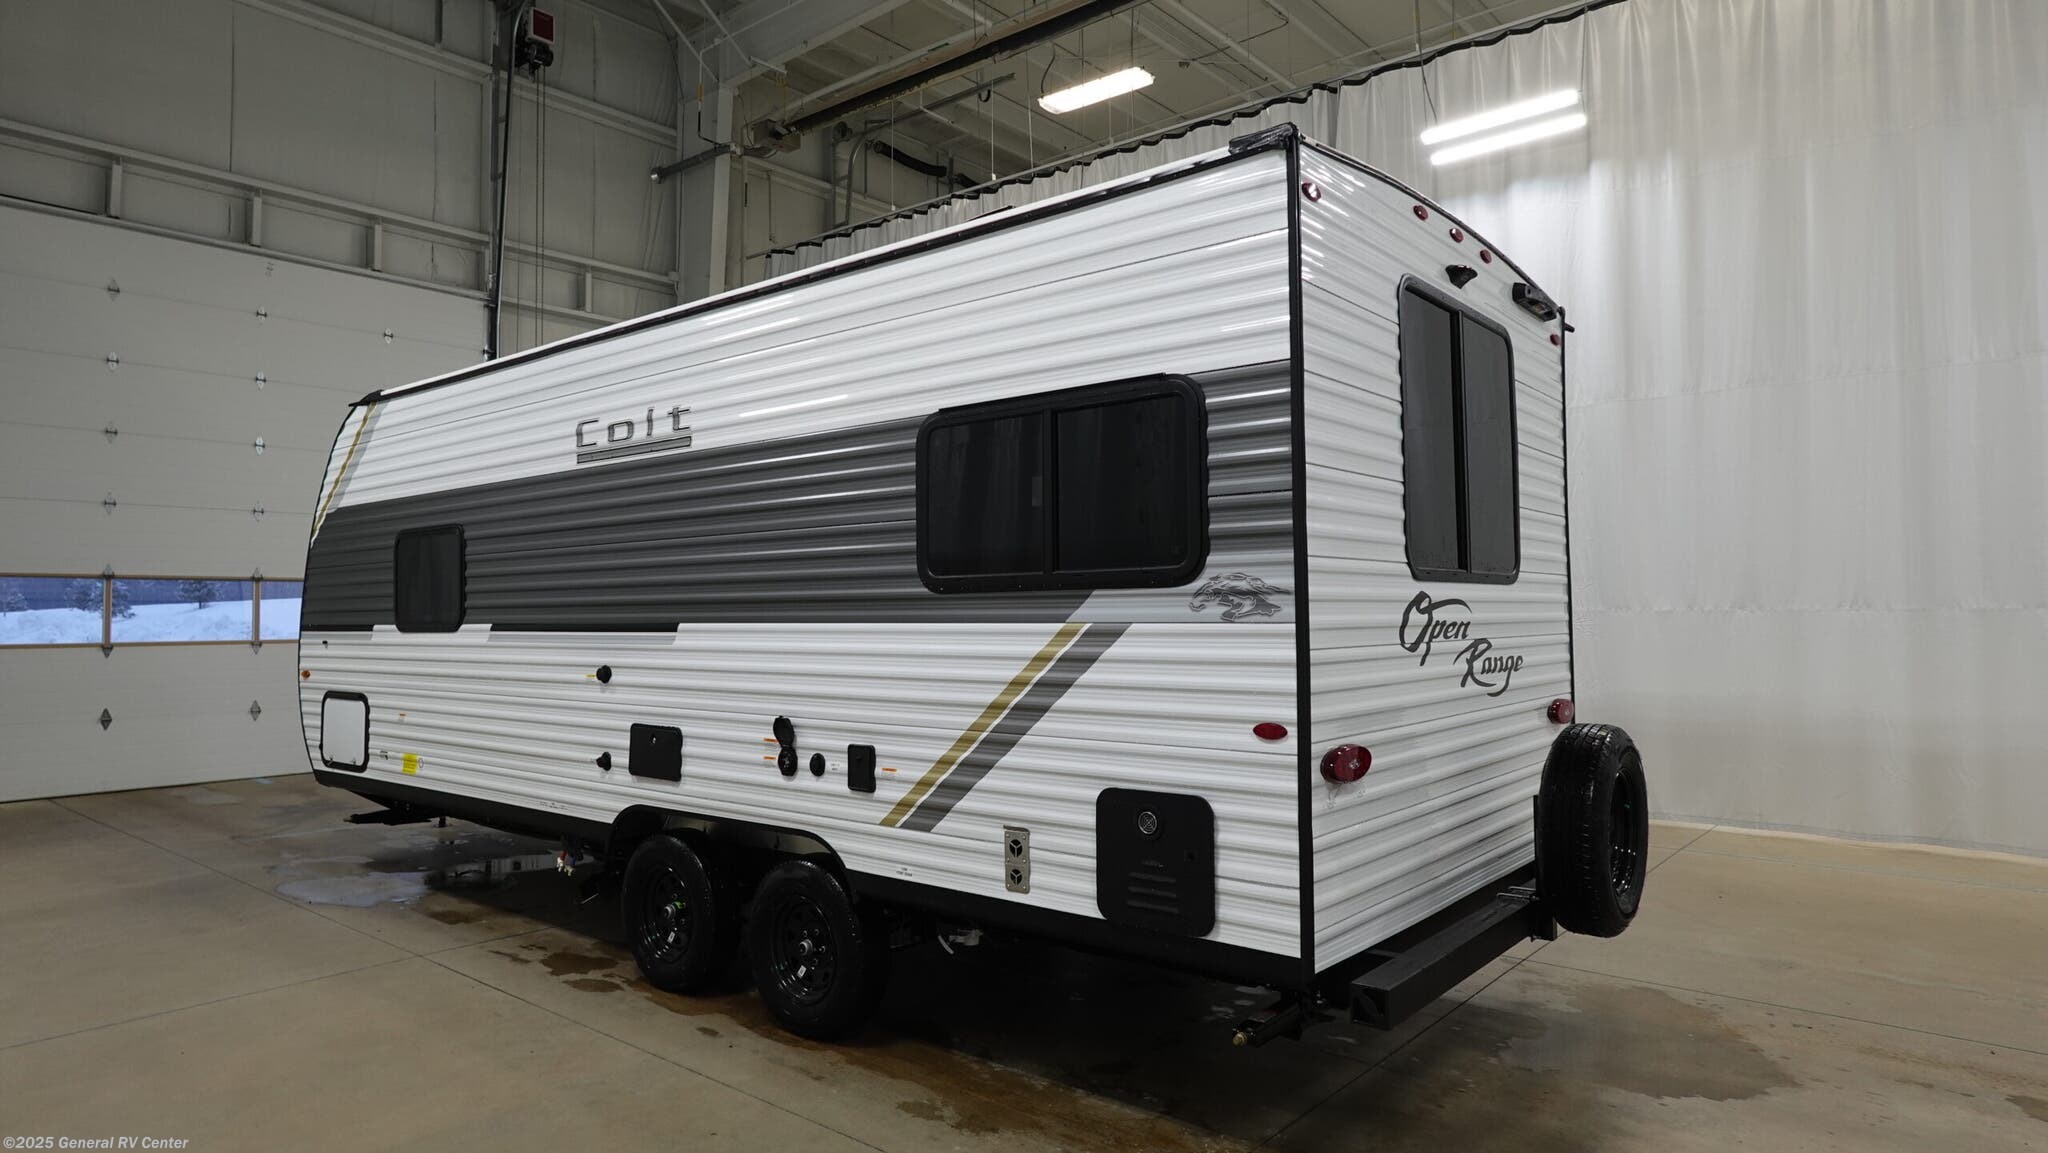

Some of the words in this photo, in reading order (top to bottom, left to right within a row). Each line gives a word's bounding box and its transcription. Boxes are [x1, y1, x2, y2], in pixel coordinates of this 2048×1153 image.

[576, 407, 691, 447] Colt
[1399, 590, 1472, 666] Open
[1453, 638, 1524, 697] Range
